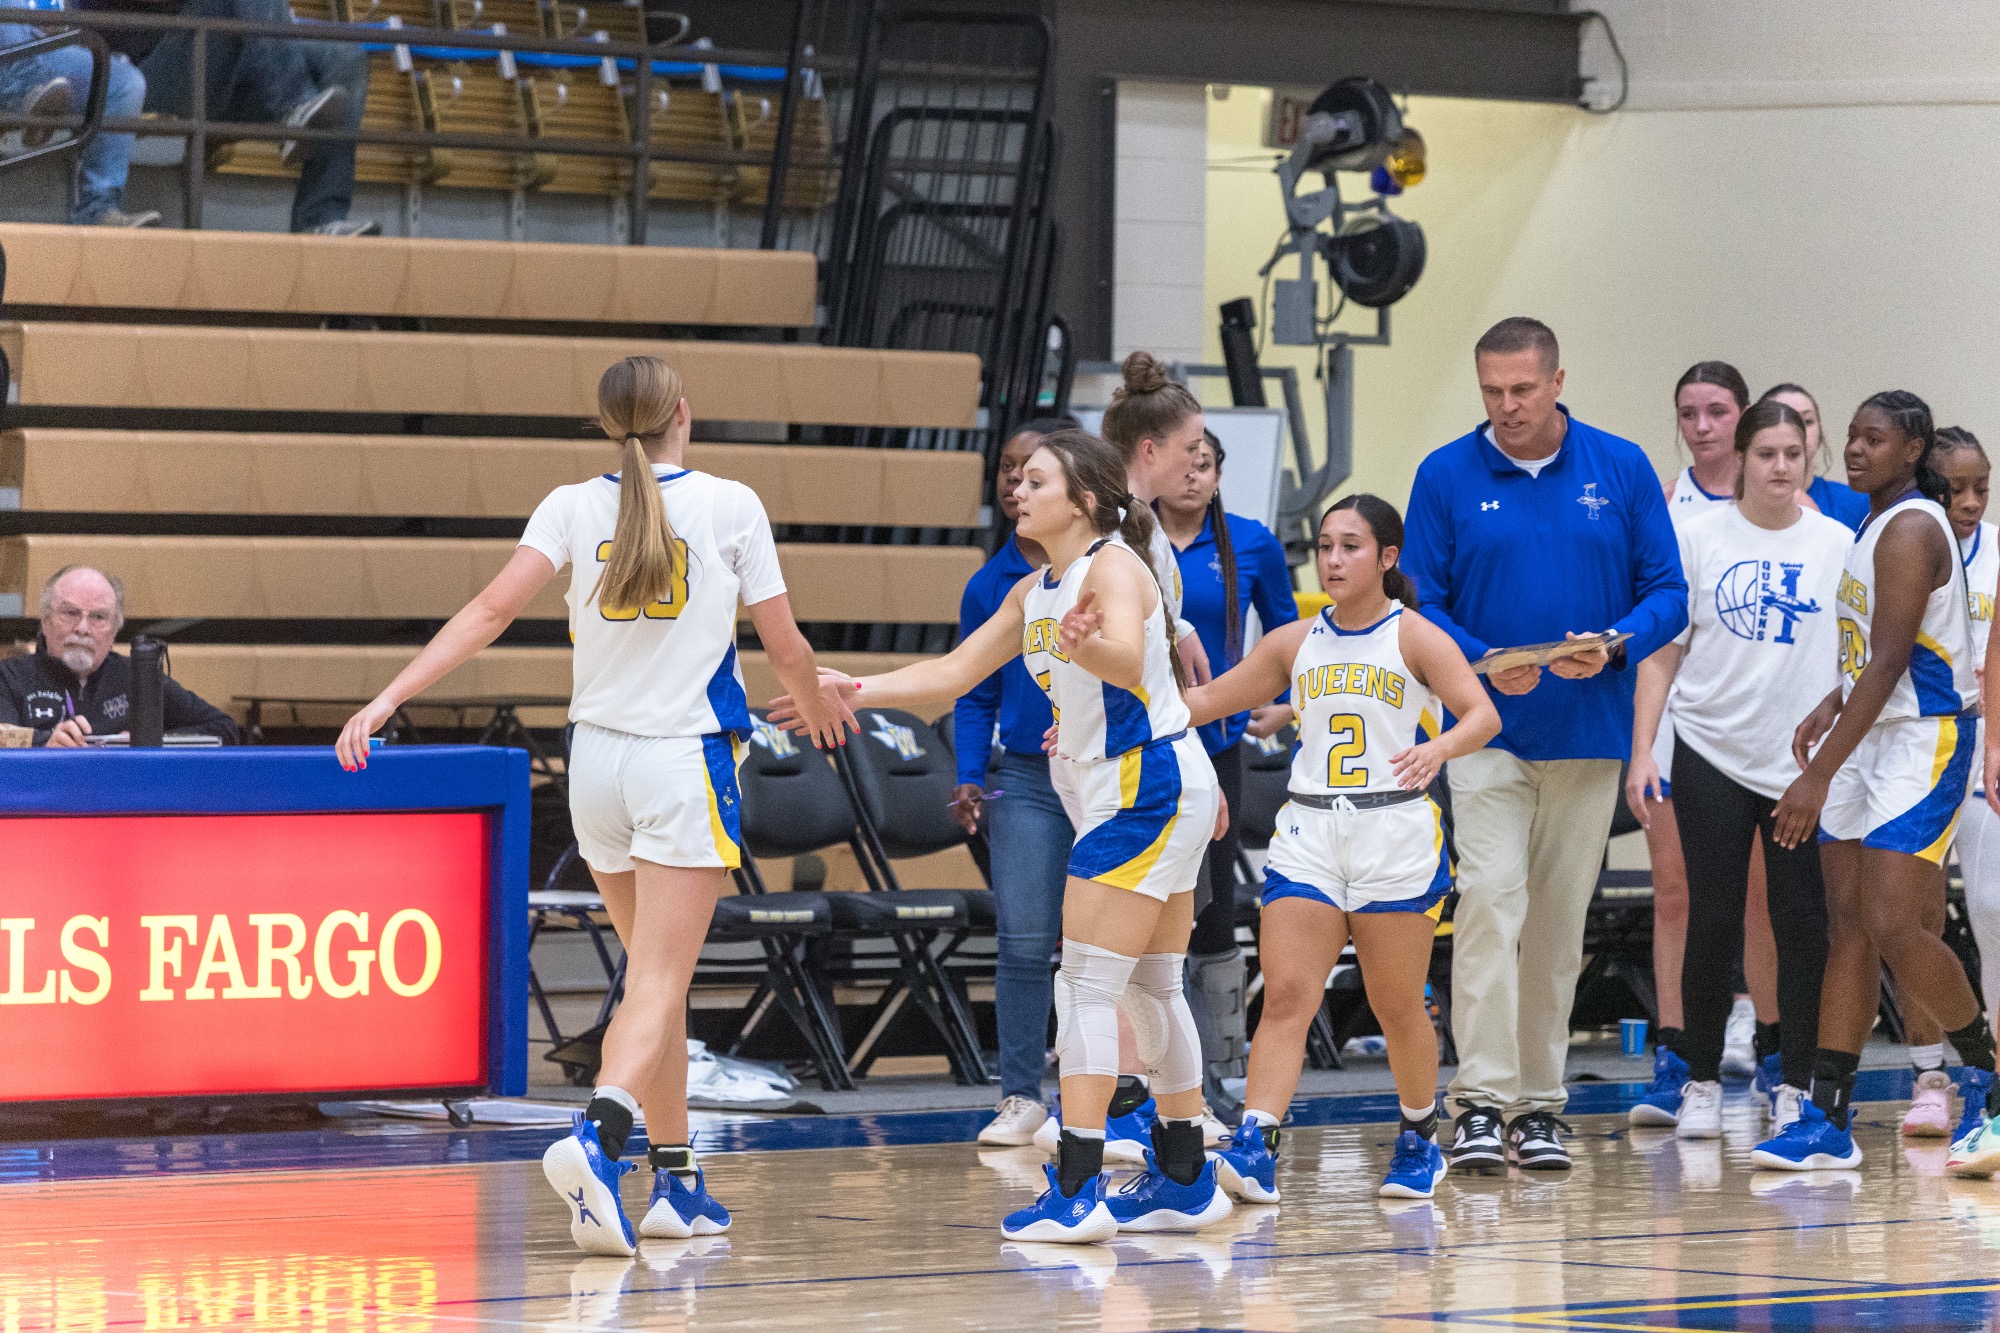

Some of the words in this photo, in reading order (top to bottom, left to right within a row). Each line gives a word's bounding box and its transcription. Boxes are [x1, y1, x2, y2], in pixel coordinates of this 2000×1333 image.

[1298, 663, 1405, 711] QUEENS
[1327, 713, 1369, 788] 2
[139, 908, 443, 1002] FARGO
